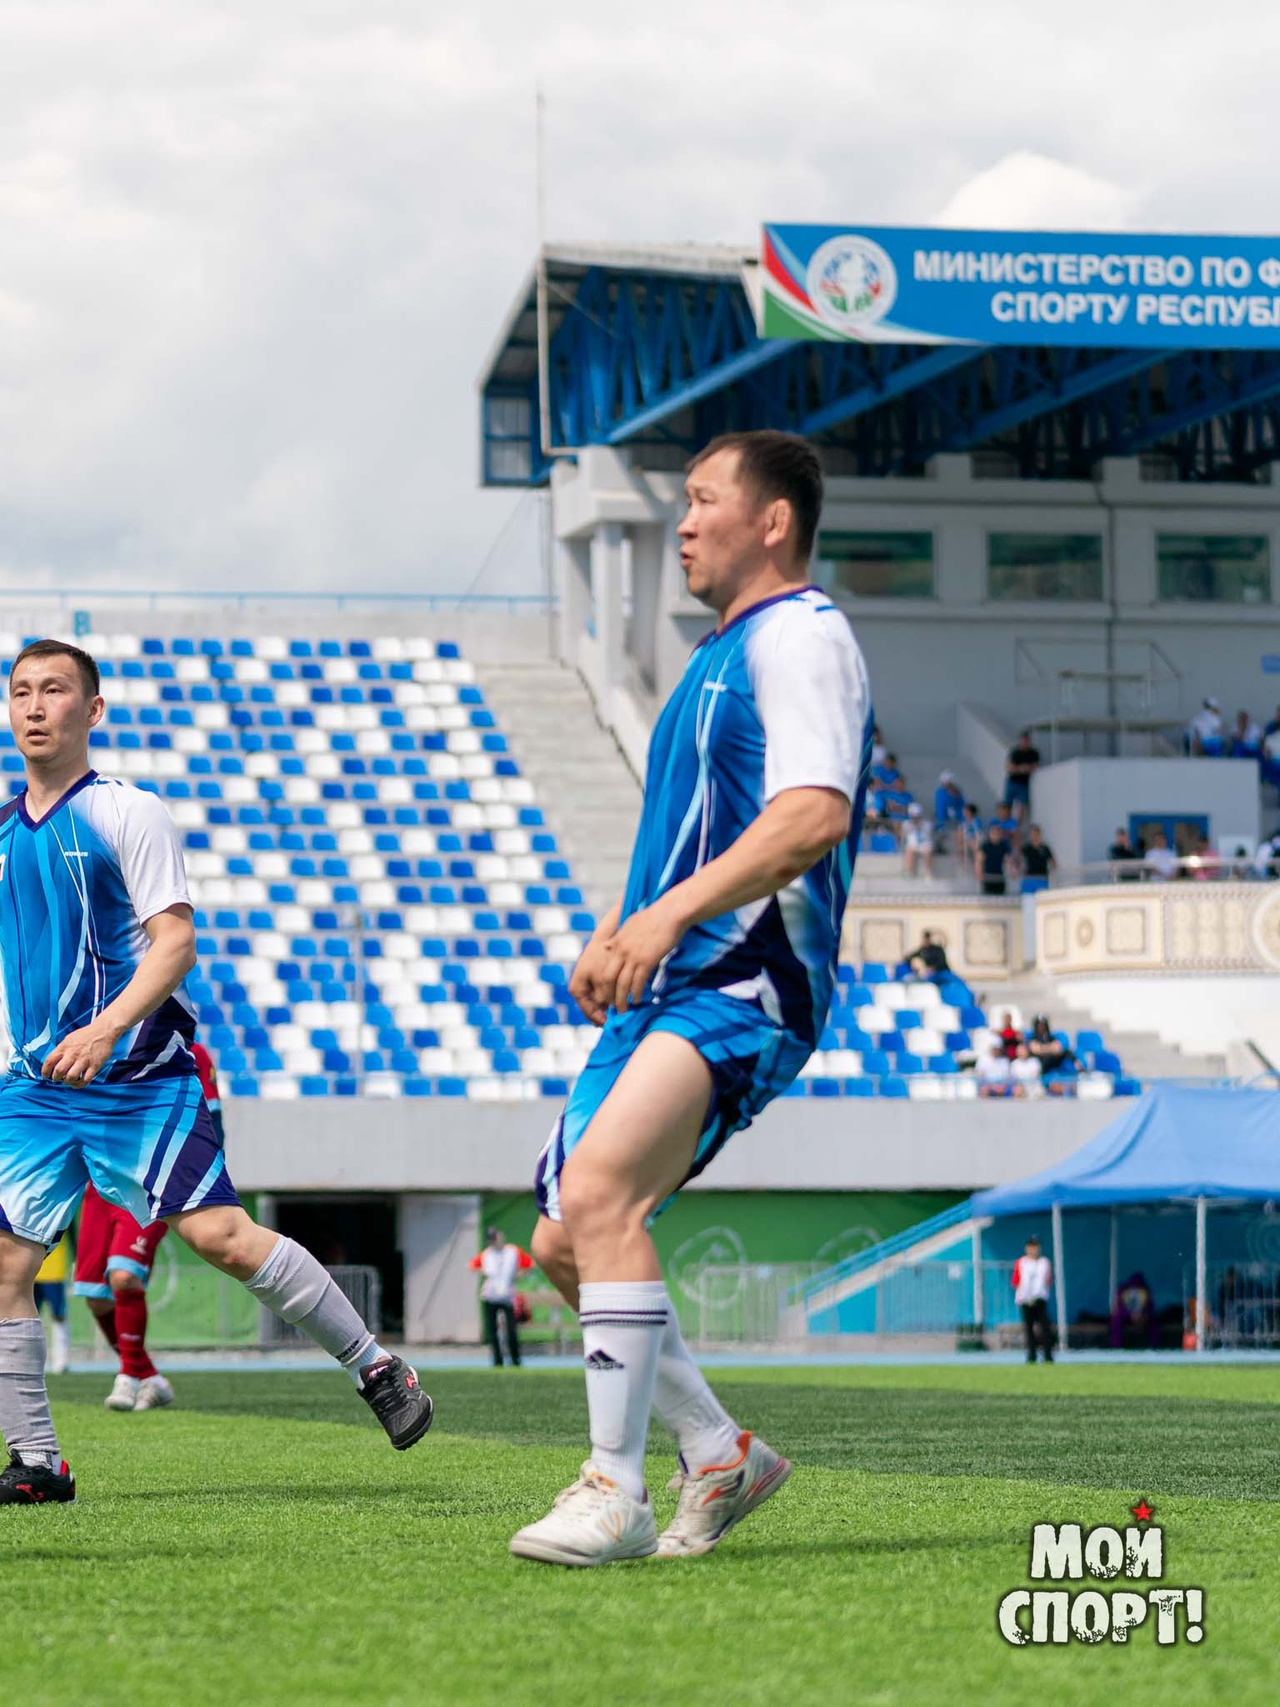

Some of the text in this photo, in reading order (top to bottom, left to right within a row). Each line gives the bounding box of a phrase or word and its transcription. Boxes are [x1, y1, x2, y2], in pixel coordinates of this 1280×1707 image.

[914, 250, 1194, 287] МИНИСТЕРСТВО
[1201, 256, 1252, 288] ПО
[991, 292, 1128, 325] СПОРТУ
